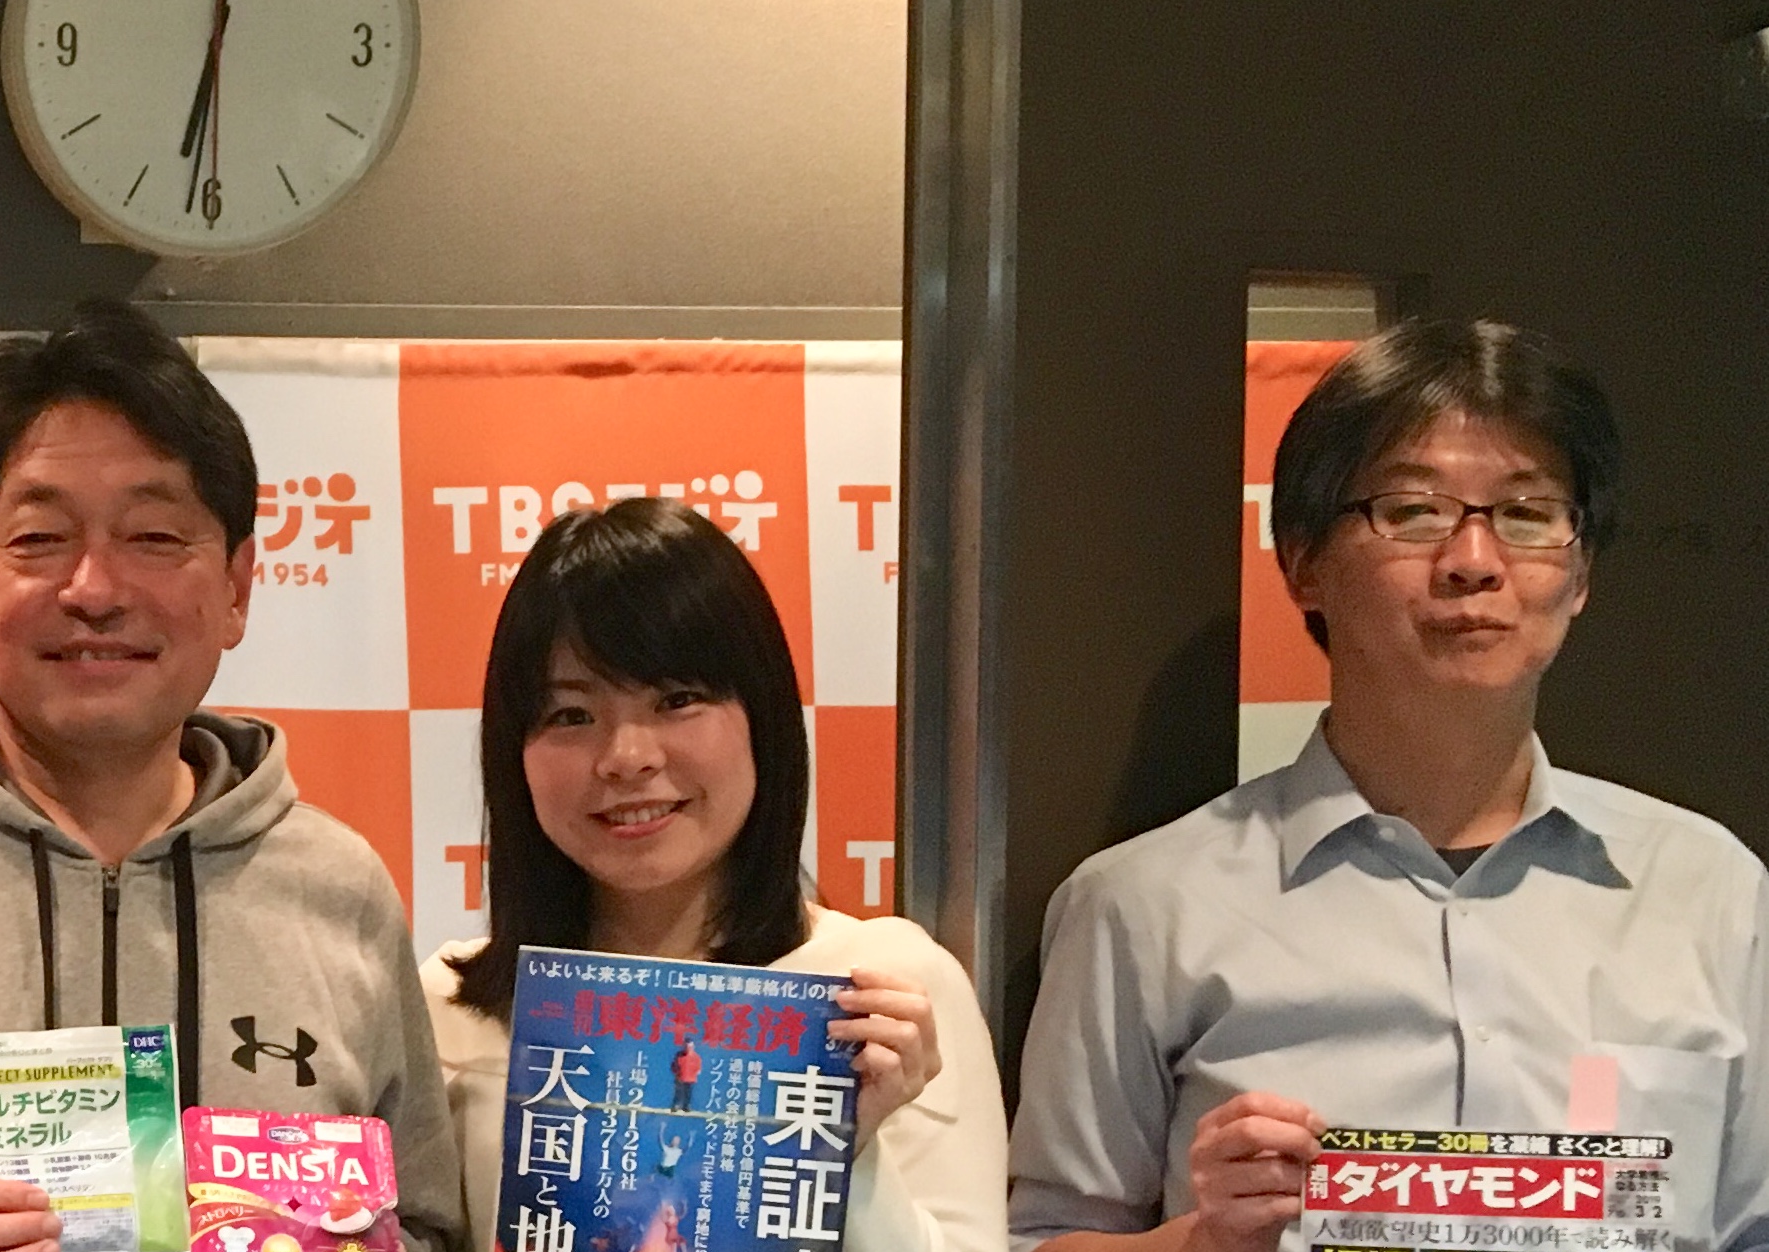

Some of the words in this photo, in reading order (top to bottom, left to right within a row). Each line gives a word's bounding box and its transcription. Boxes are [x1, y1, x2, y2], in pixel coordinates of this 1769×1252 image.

[56, 22, 78, 66] 9
[351, 23, 374, 67] 3
[201, 178, 222, 222] 6
[133, 1035, 163, 1048] DHC
[594, 991, 808, 1056] 東洋経済
[25, 1063, 114, 1081] SUPPLEMENT
[211, 1144, 370, 1186] DENSIA
[1332, 1160, 1602, 1211] ダイヤモンド
